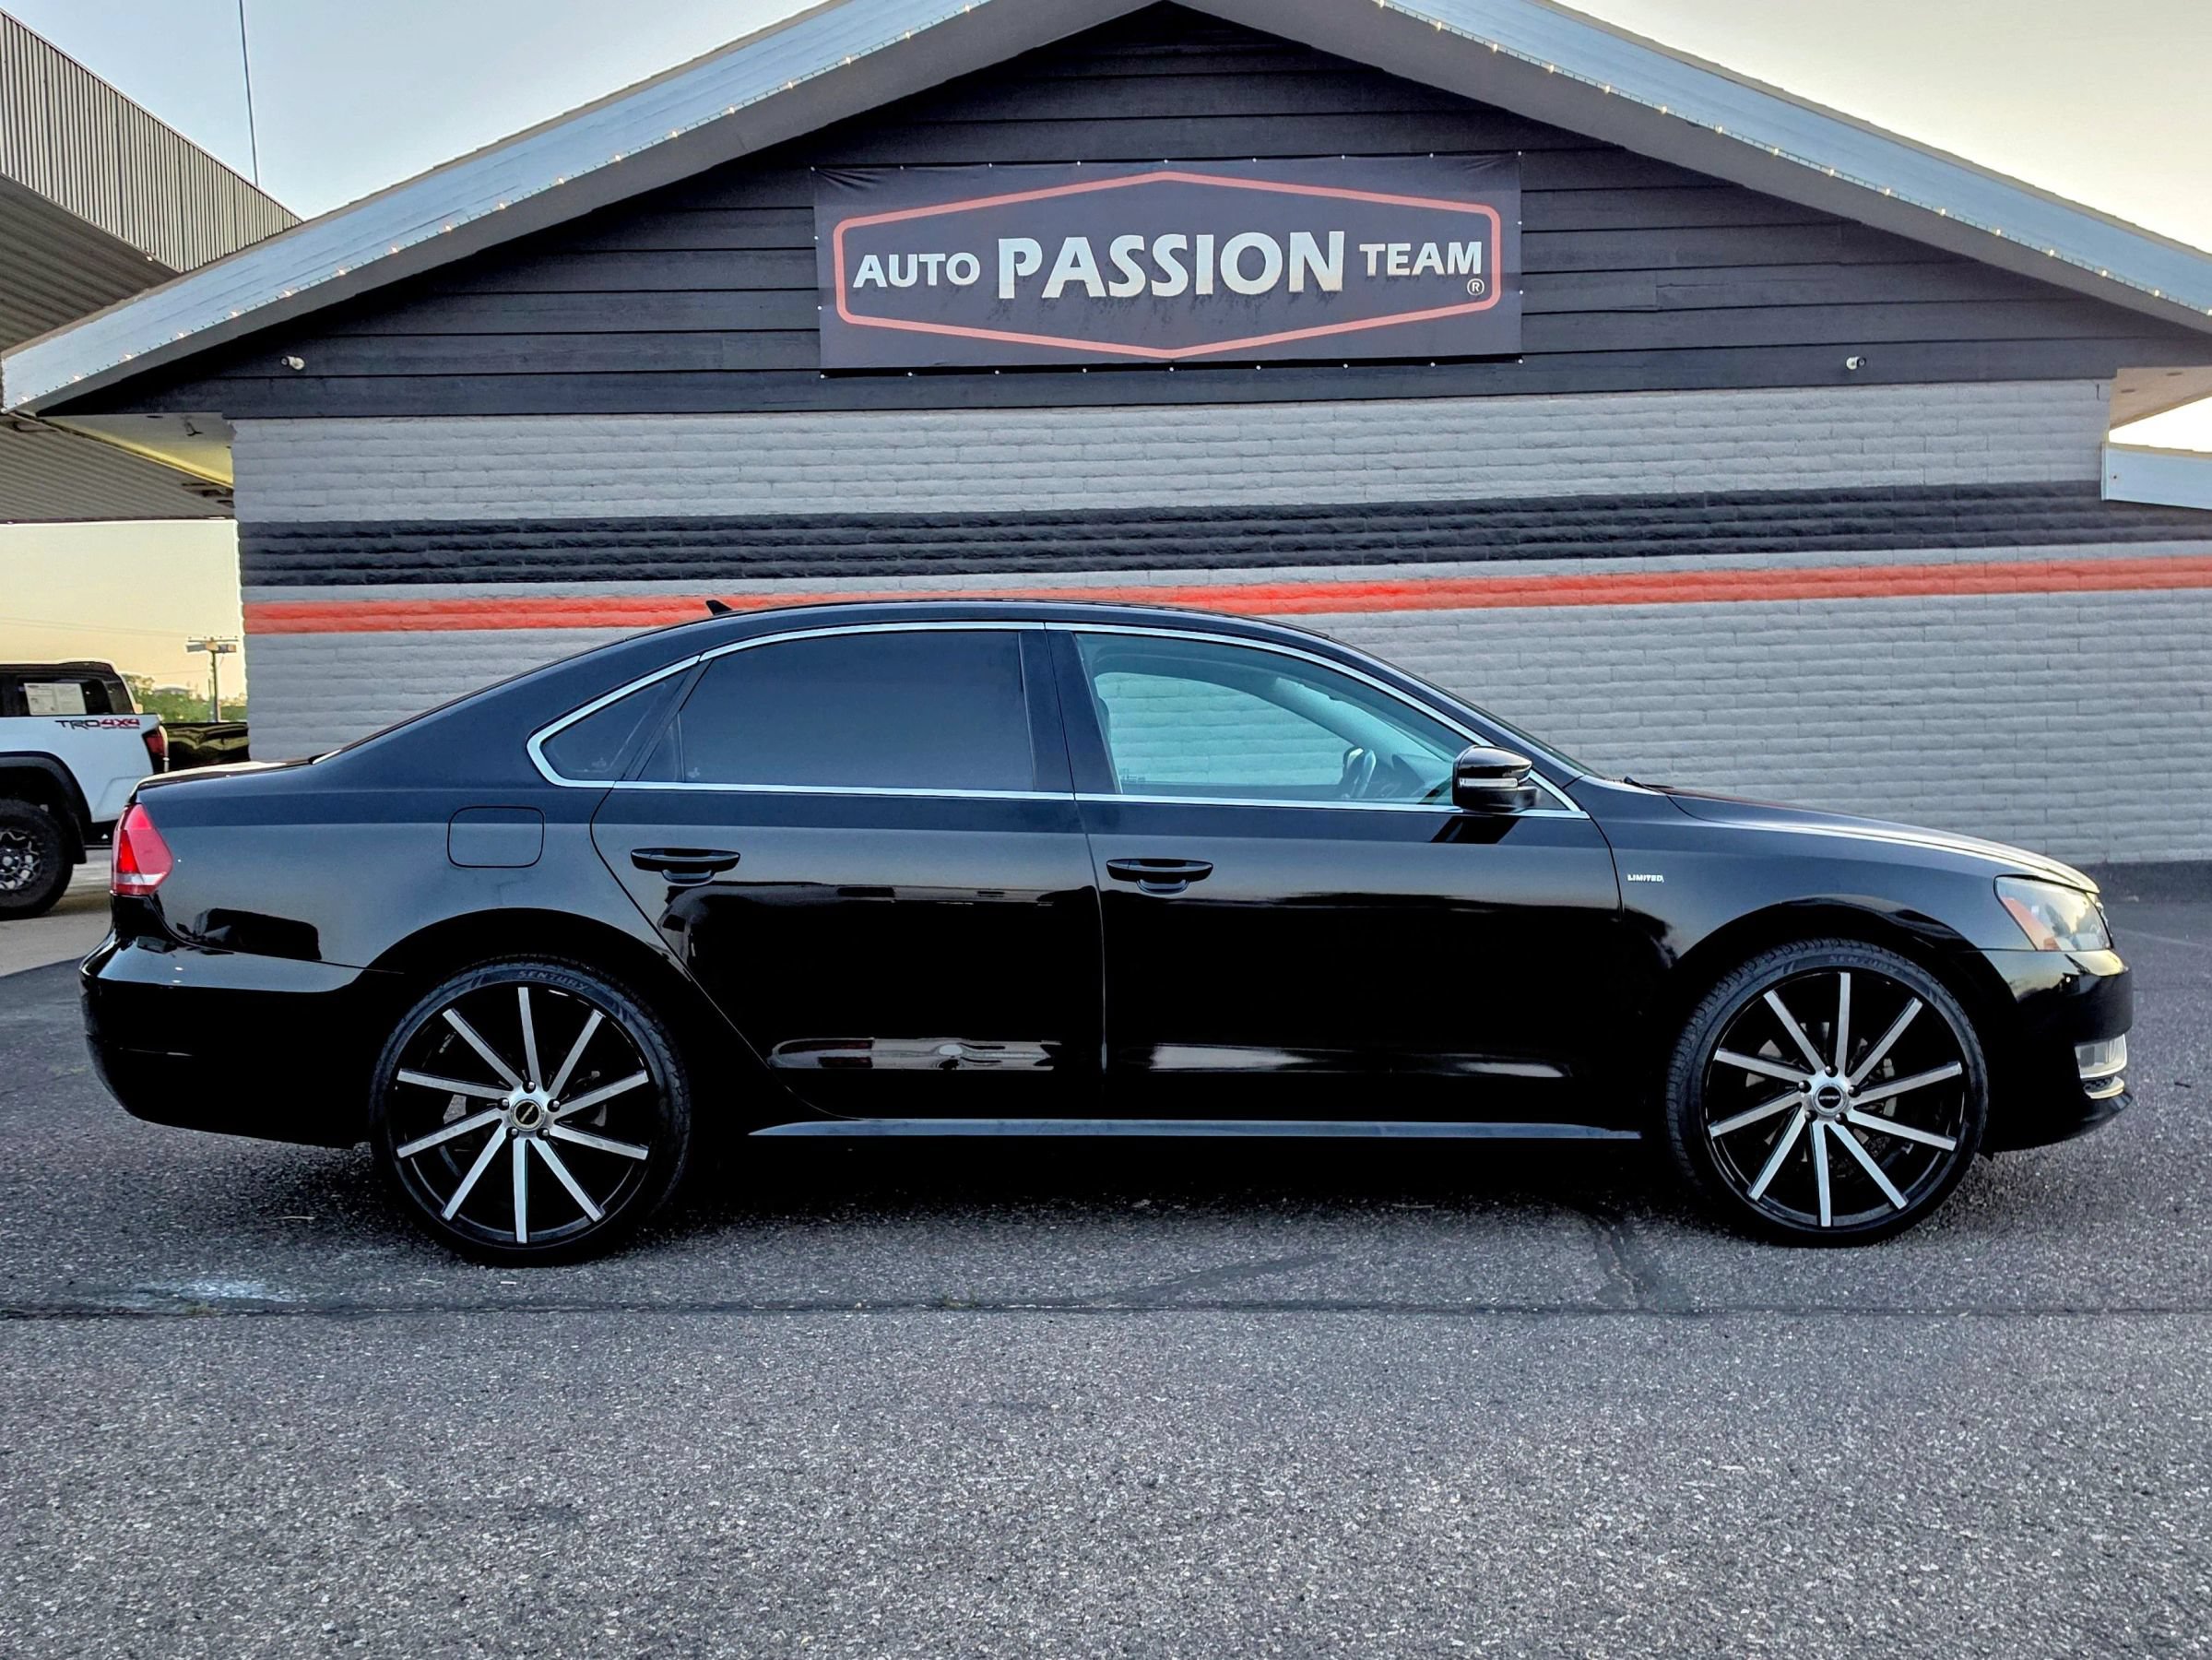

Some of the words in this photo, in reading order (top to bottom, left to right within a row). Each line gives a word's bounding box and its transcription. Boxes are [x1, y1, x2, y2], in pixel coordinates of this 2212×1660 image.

[852, 252, 981, 289] AUTO
[998, 231, 1345, 300] PASSION
[1359, 241, 1483, 277] TEAM
